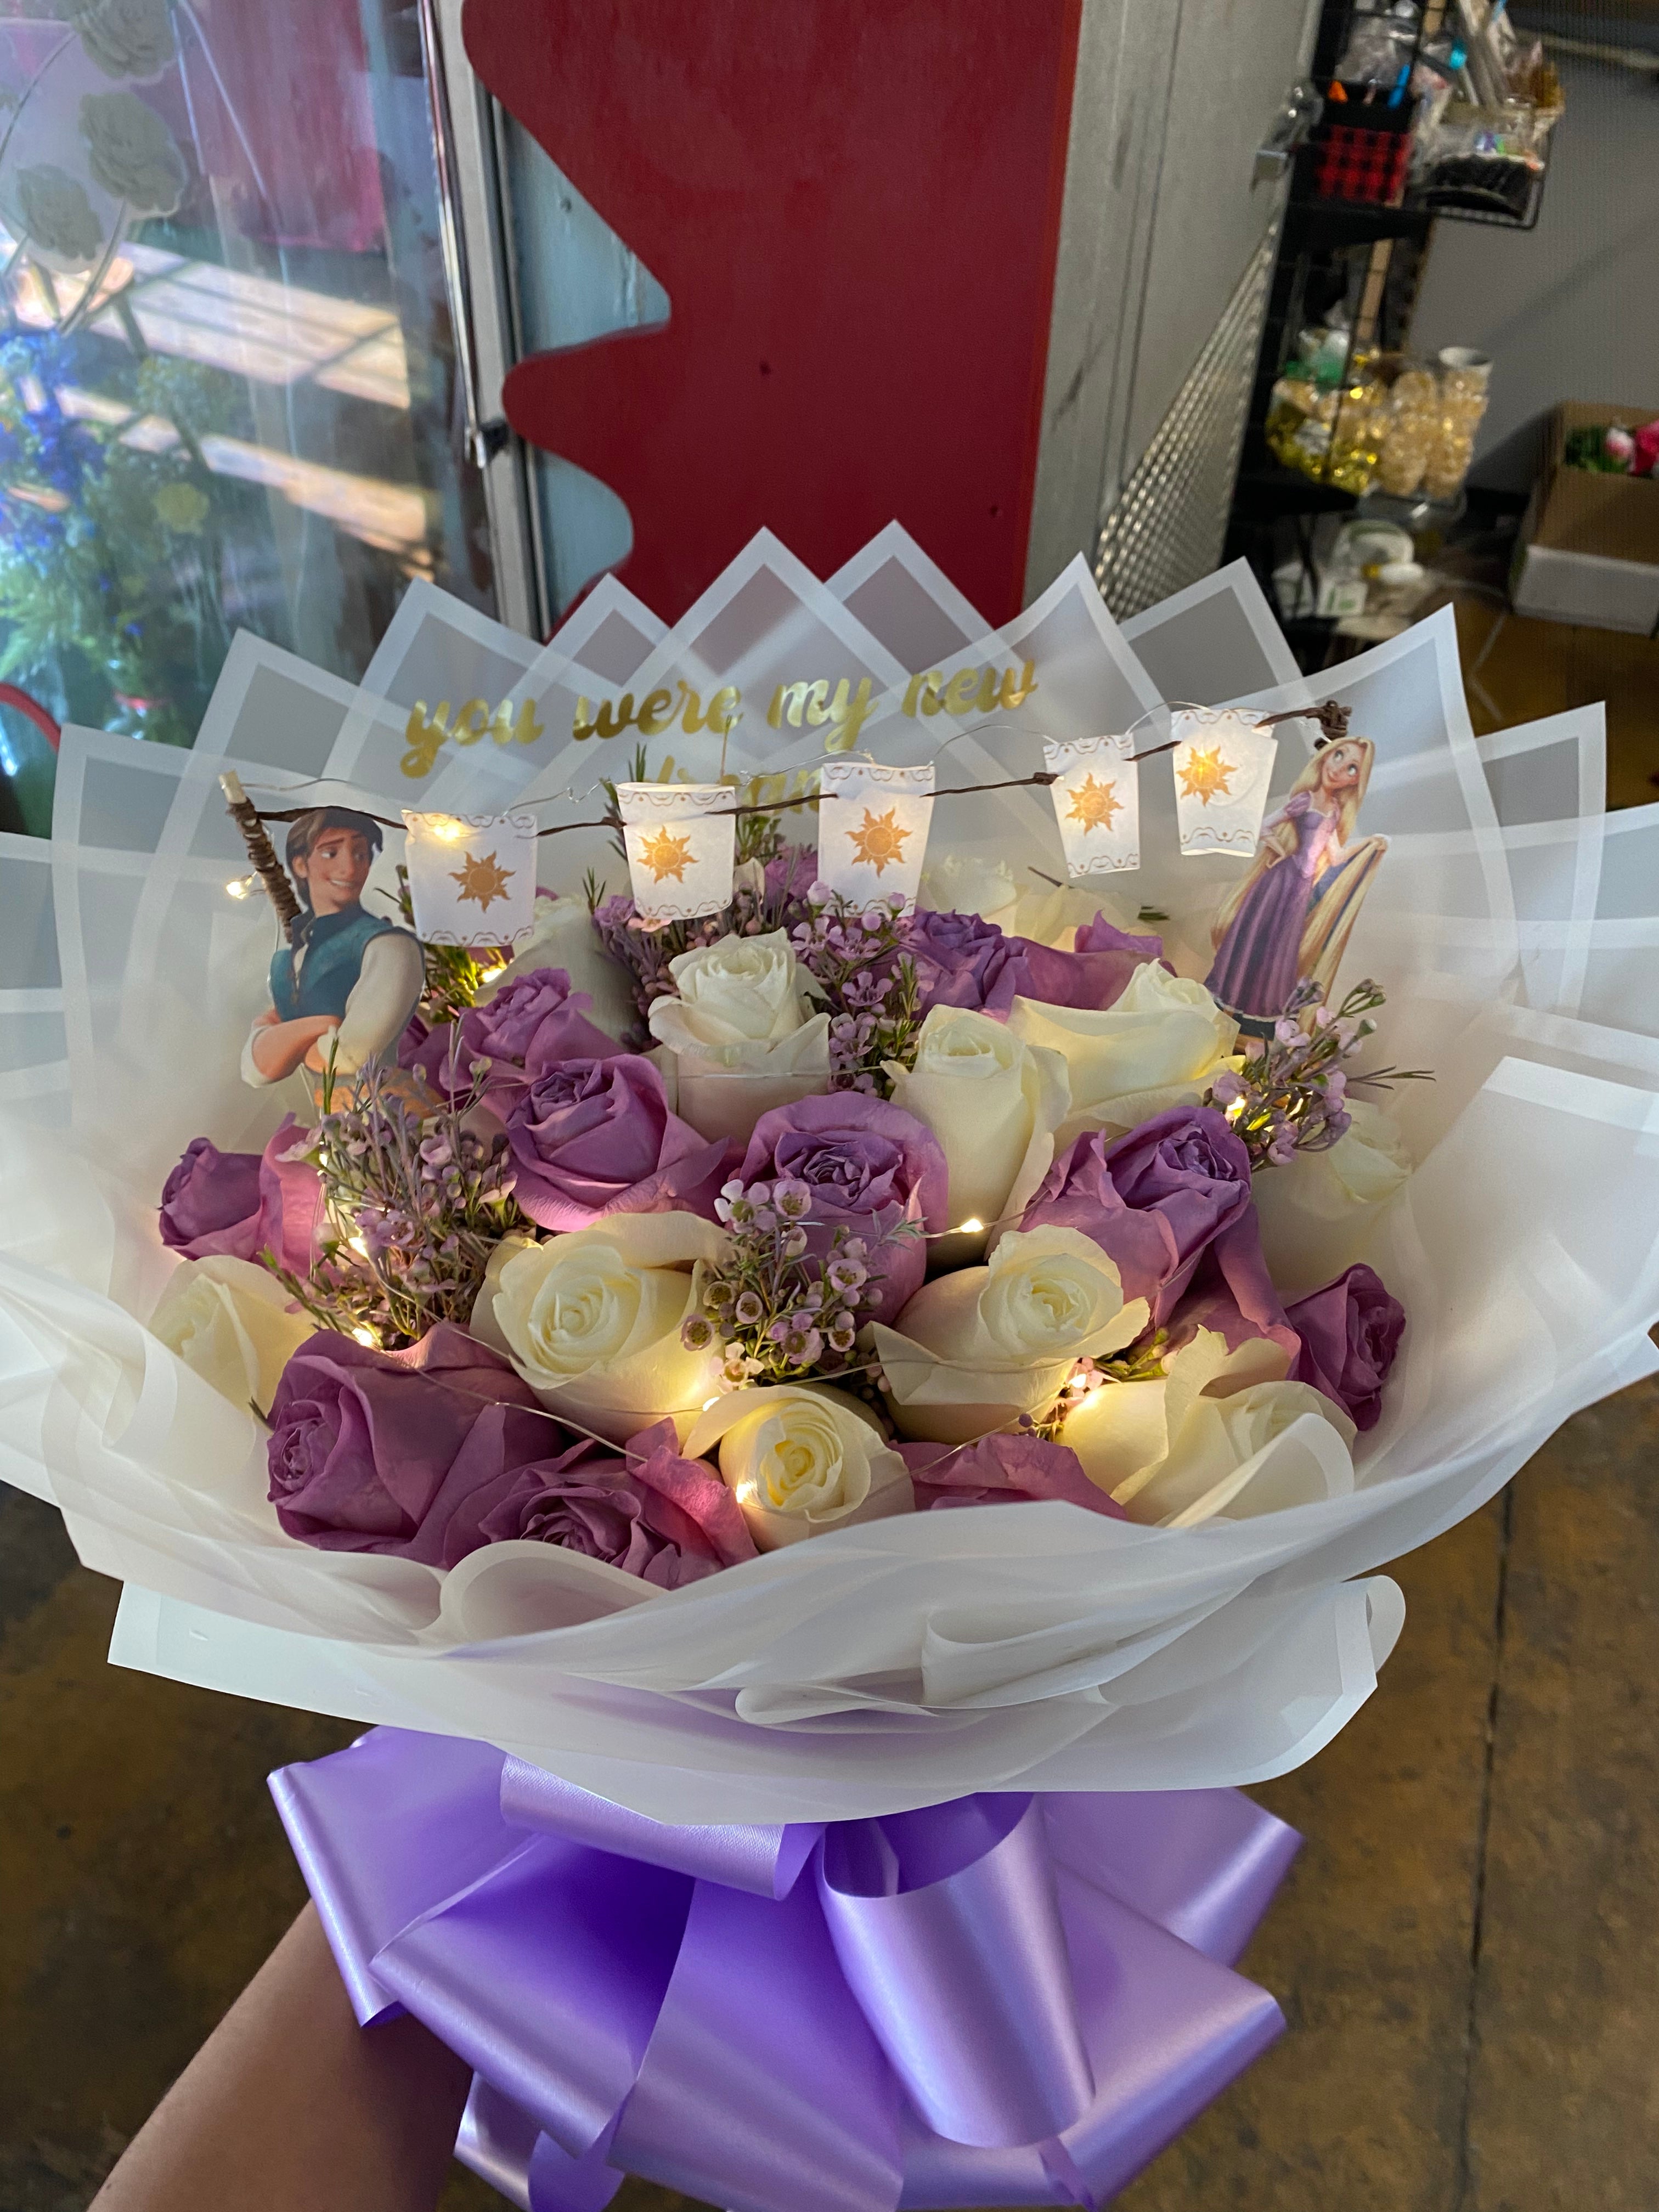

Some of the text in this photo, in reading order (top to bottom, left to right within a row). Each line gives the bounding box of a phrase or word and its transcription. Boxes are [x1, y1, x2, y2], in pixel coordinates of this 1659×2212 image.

[400, 659, 1038, 778] you were my new
